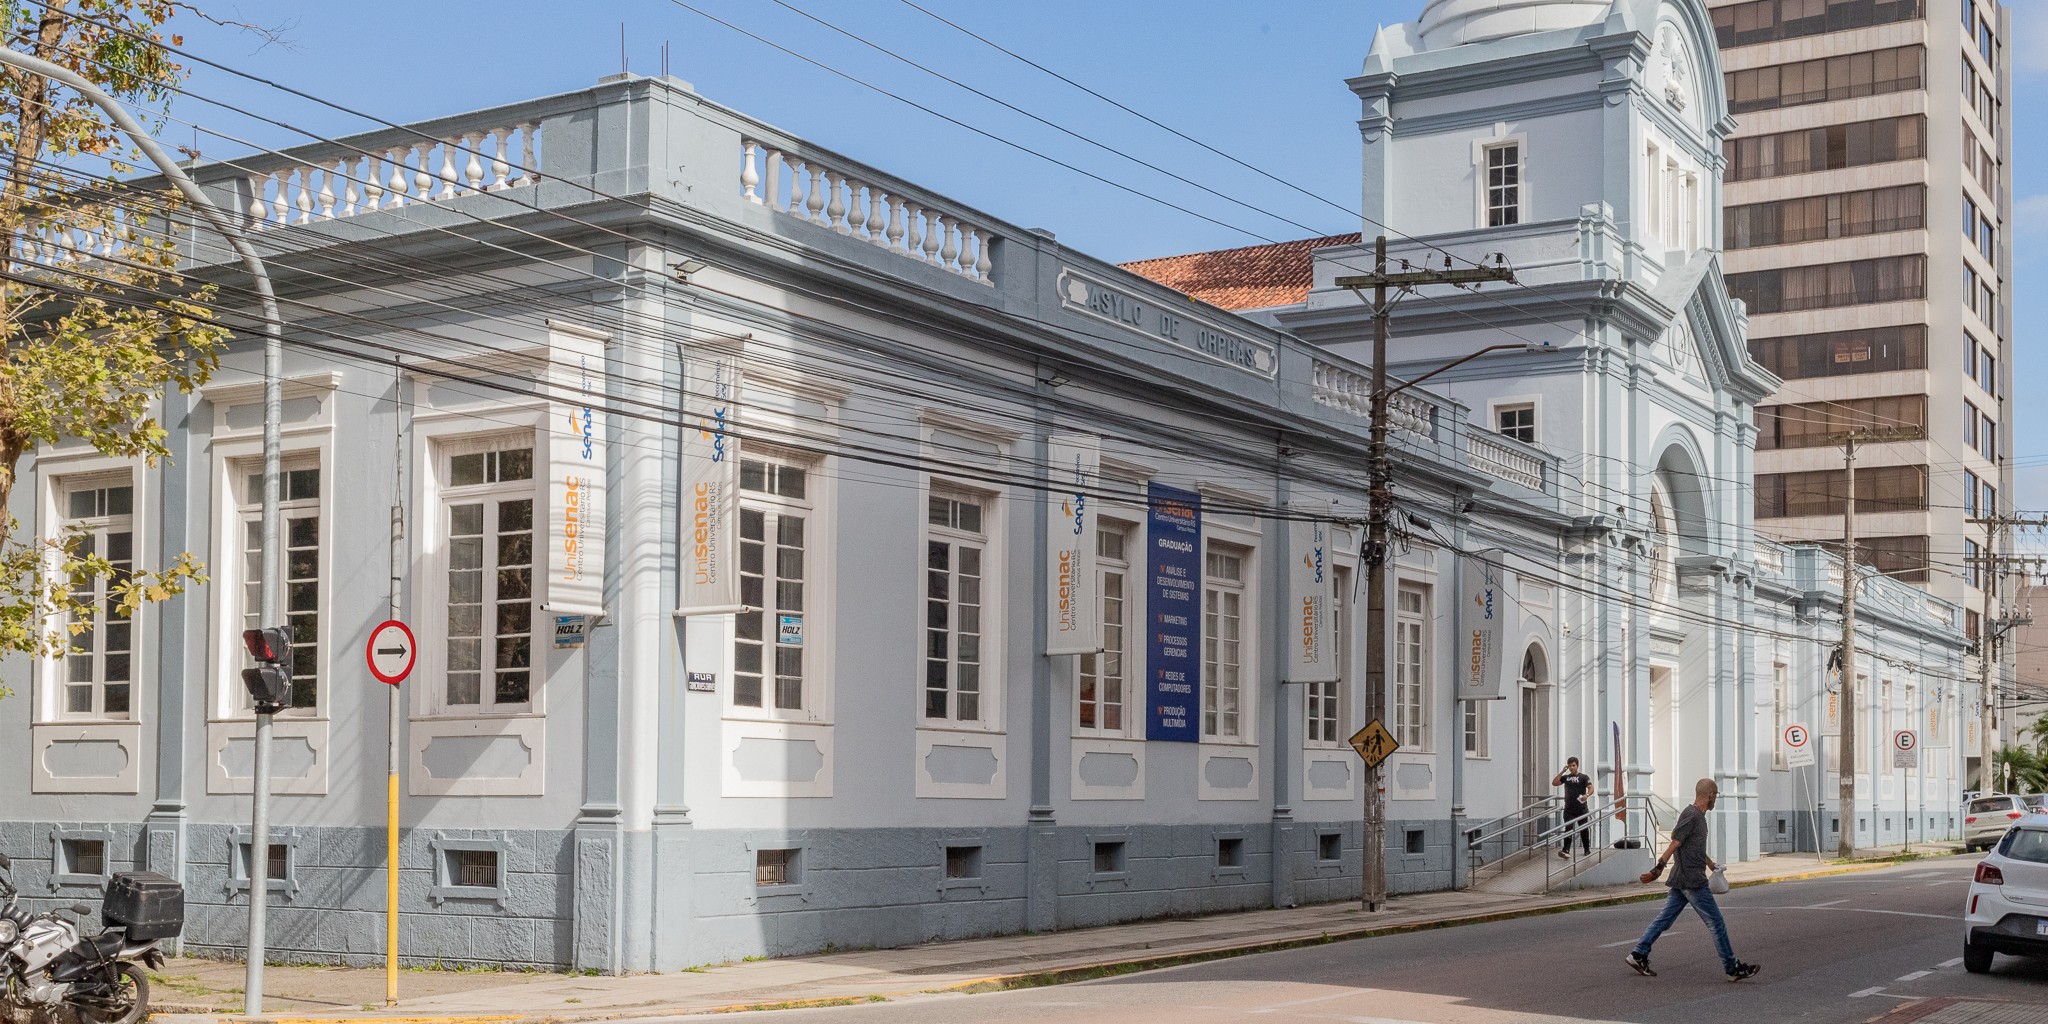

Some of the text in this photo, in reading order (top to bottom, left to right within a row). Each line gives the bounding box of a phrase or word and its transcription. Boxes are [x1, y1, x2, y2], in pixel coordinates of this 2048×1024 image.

[1089, 287, 1142, 326] ASYLO
[1160, 312, 1180, 341] DE
[580, 477, 586, 491] RS
[563, 475, 579, 581] Unisenac
[695, 482, 709, 585] Unisenac
[709, 481, 717, 584] Centro Universitário RS
[1158, 538, 1193, 553] GRADUAÇÃO
[1314, 546, 1323, 583] Senac
[1059, 550, 1071, 632] Unisenac
[1162, 589, 1190, 602] DE SISTEMAS
[1313, 595, 1318, 604] RS
[1485, 588, 1493, 620] Senac
[1164, 614, 1187, 626] MARKETING
[556, 624, 583, 635] HOLZ
[782, 625, 800, 635] HOLZ
[1303, 595, 1313, 664] Unisenac
[1163, 635, 1188, 646] PROCESSOS
[1470, 629, 1482, 687] Unisenac
[694, 673, 711, 681] RUA
[1165, 671, 1185, 681] REDES DE
[1159, 682, 1192, 693] COMPUTADORES
[1791, 730, 1801, 743] E
[1901, 735, 1909, 747] E
